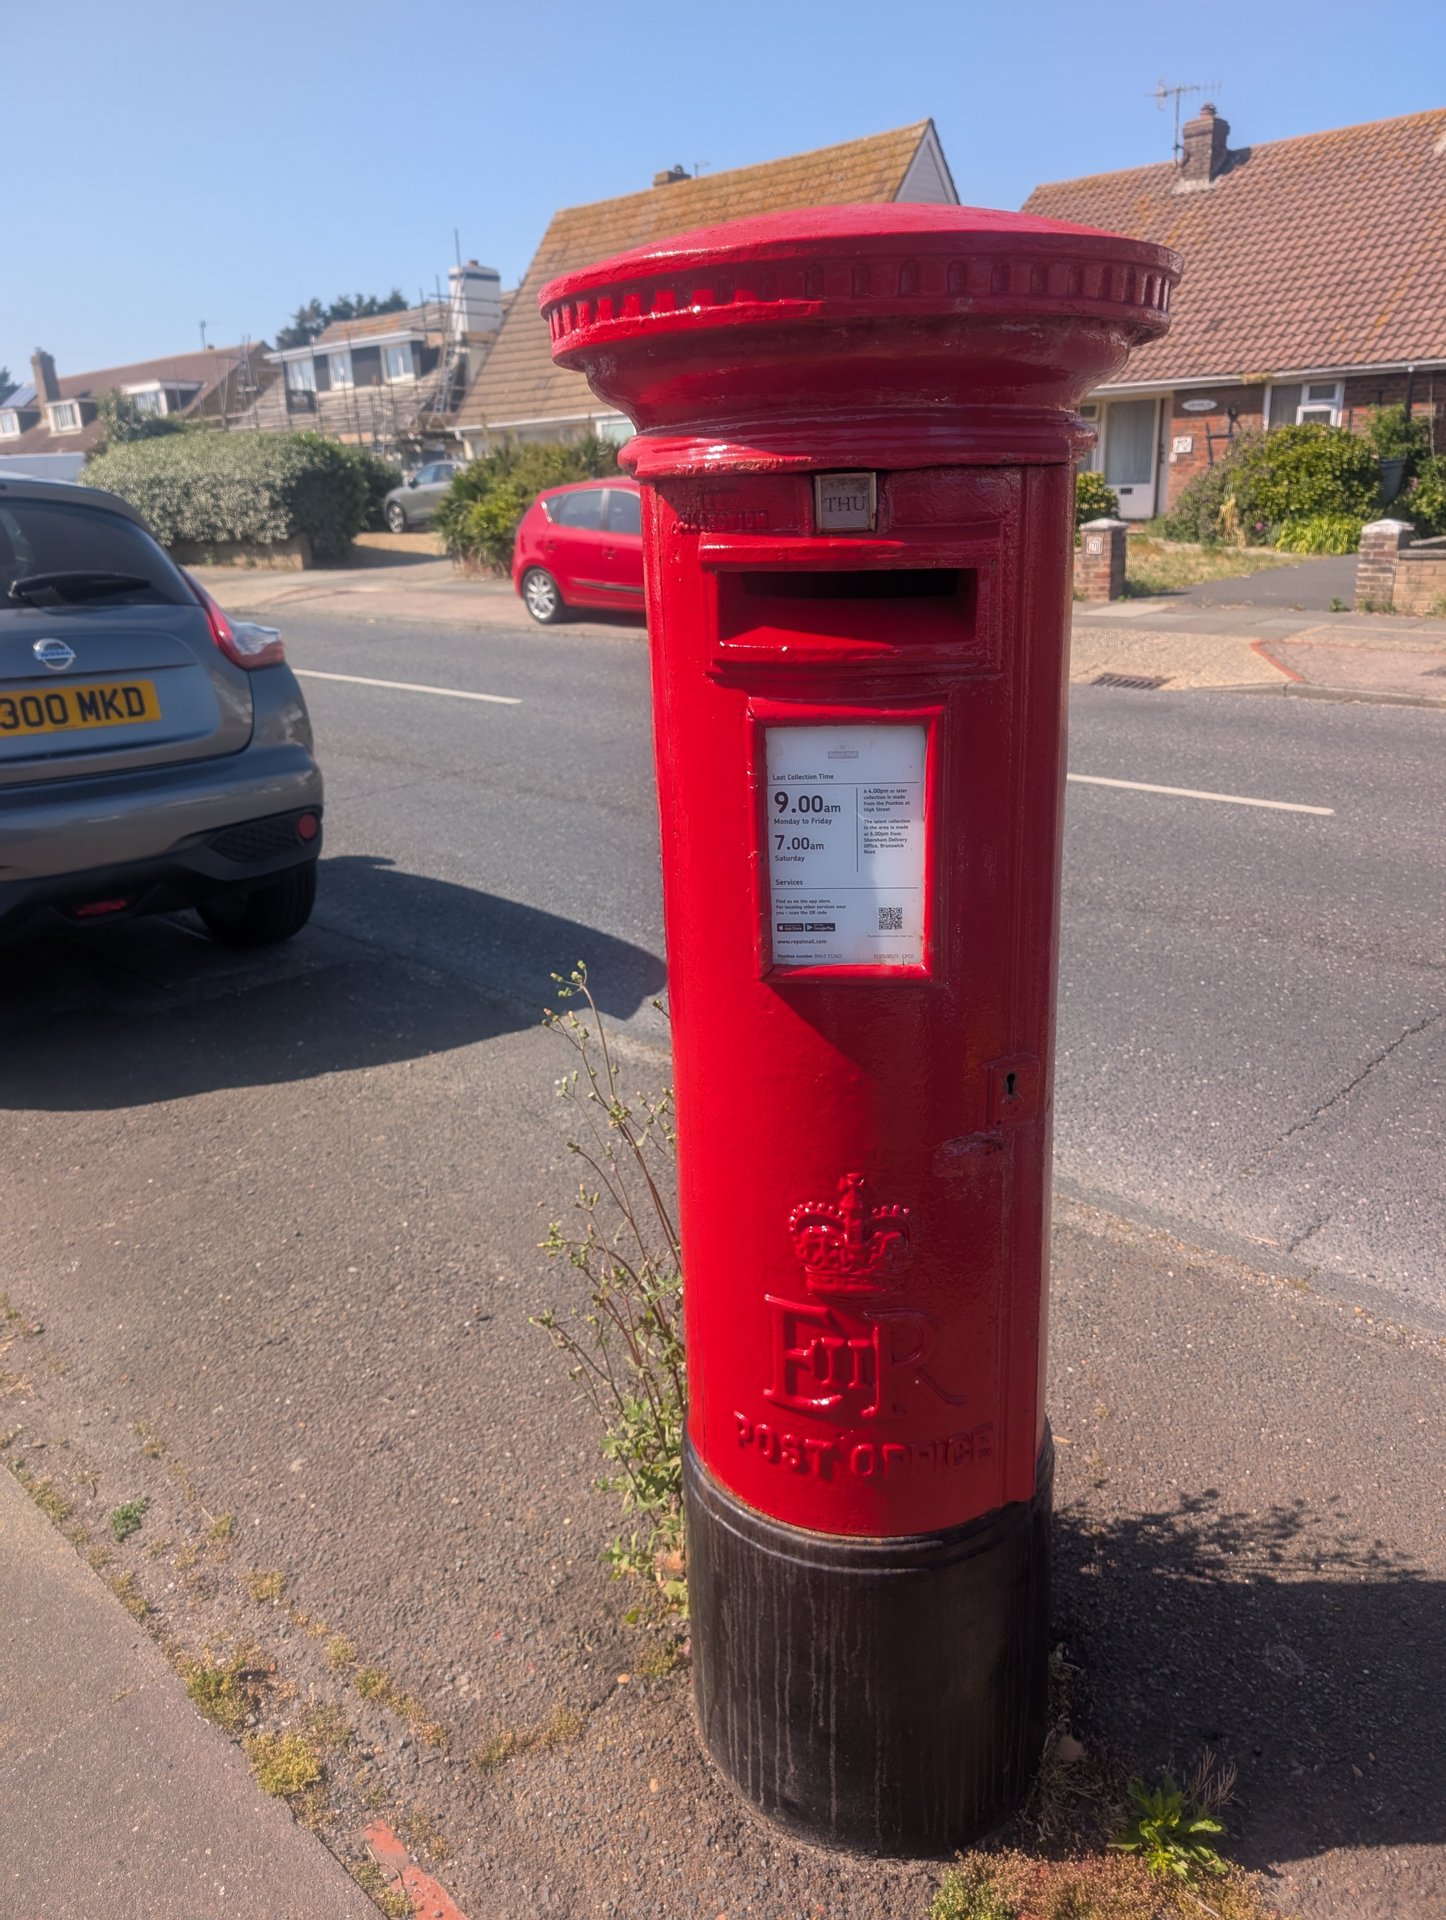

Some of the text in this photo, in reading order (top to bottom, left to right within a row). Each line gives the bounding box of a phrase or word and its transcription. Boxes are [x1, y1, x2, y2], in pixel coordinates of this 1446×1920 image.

[823, 495, 867, 513] THU
[41, 650, 71, 658] NISSAN
[75, 686, 146, 722] MKD
[774, 791, 841, 814] 9.00am
[774, 834, 825, 850] 7.00am
[774, 855, 805, 863] Saturday
[776, 878, 804, 886] Services
[733, 1410, 834, 1479] POST
